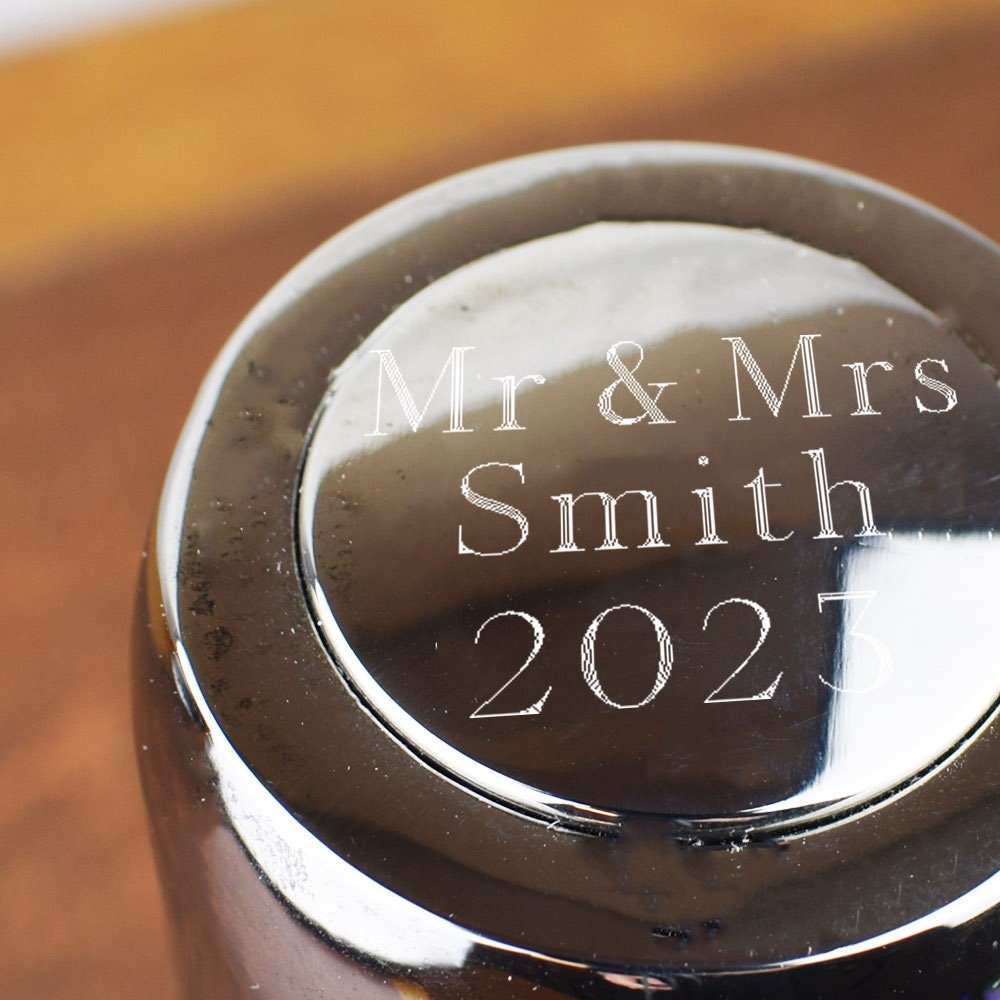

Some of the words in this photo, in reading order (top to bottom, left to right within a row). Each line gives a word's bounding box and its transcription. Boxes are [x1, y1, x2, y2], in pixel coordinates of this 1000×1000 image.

[364, 346, 546, 436] Mr
[597, 340, 678, 426] &
[721, 334, 958, 421] Mrs
[458, 447, 887, 556] Smith
[469, 590, 894, 719] 2023
